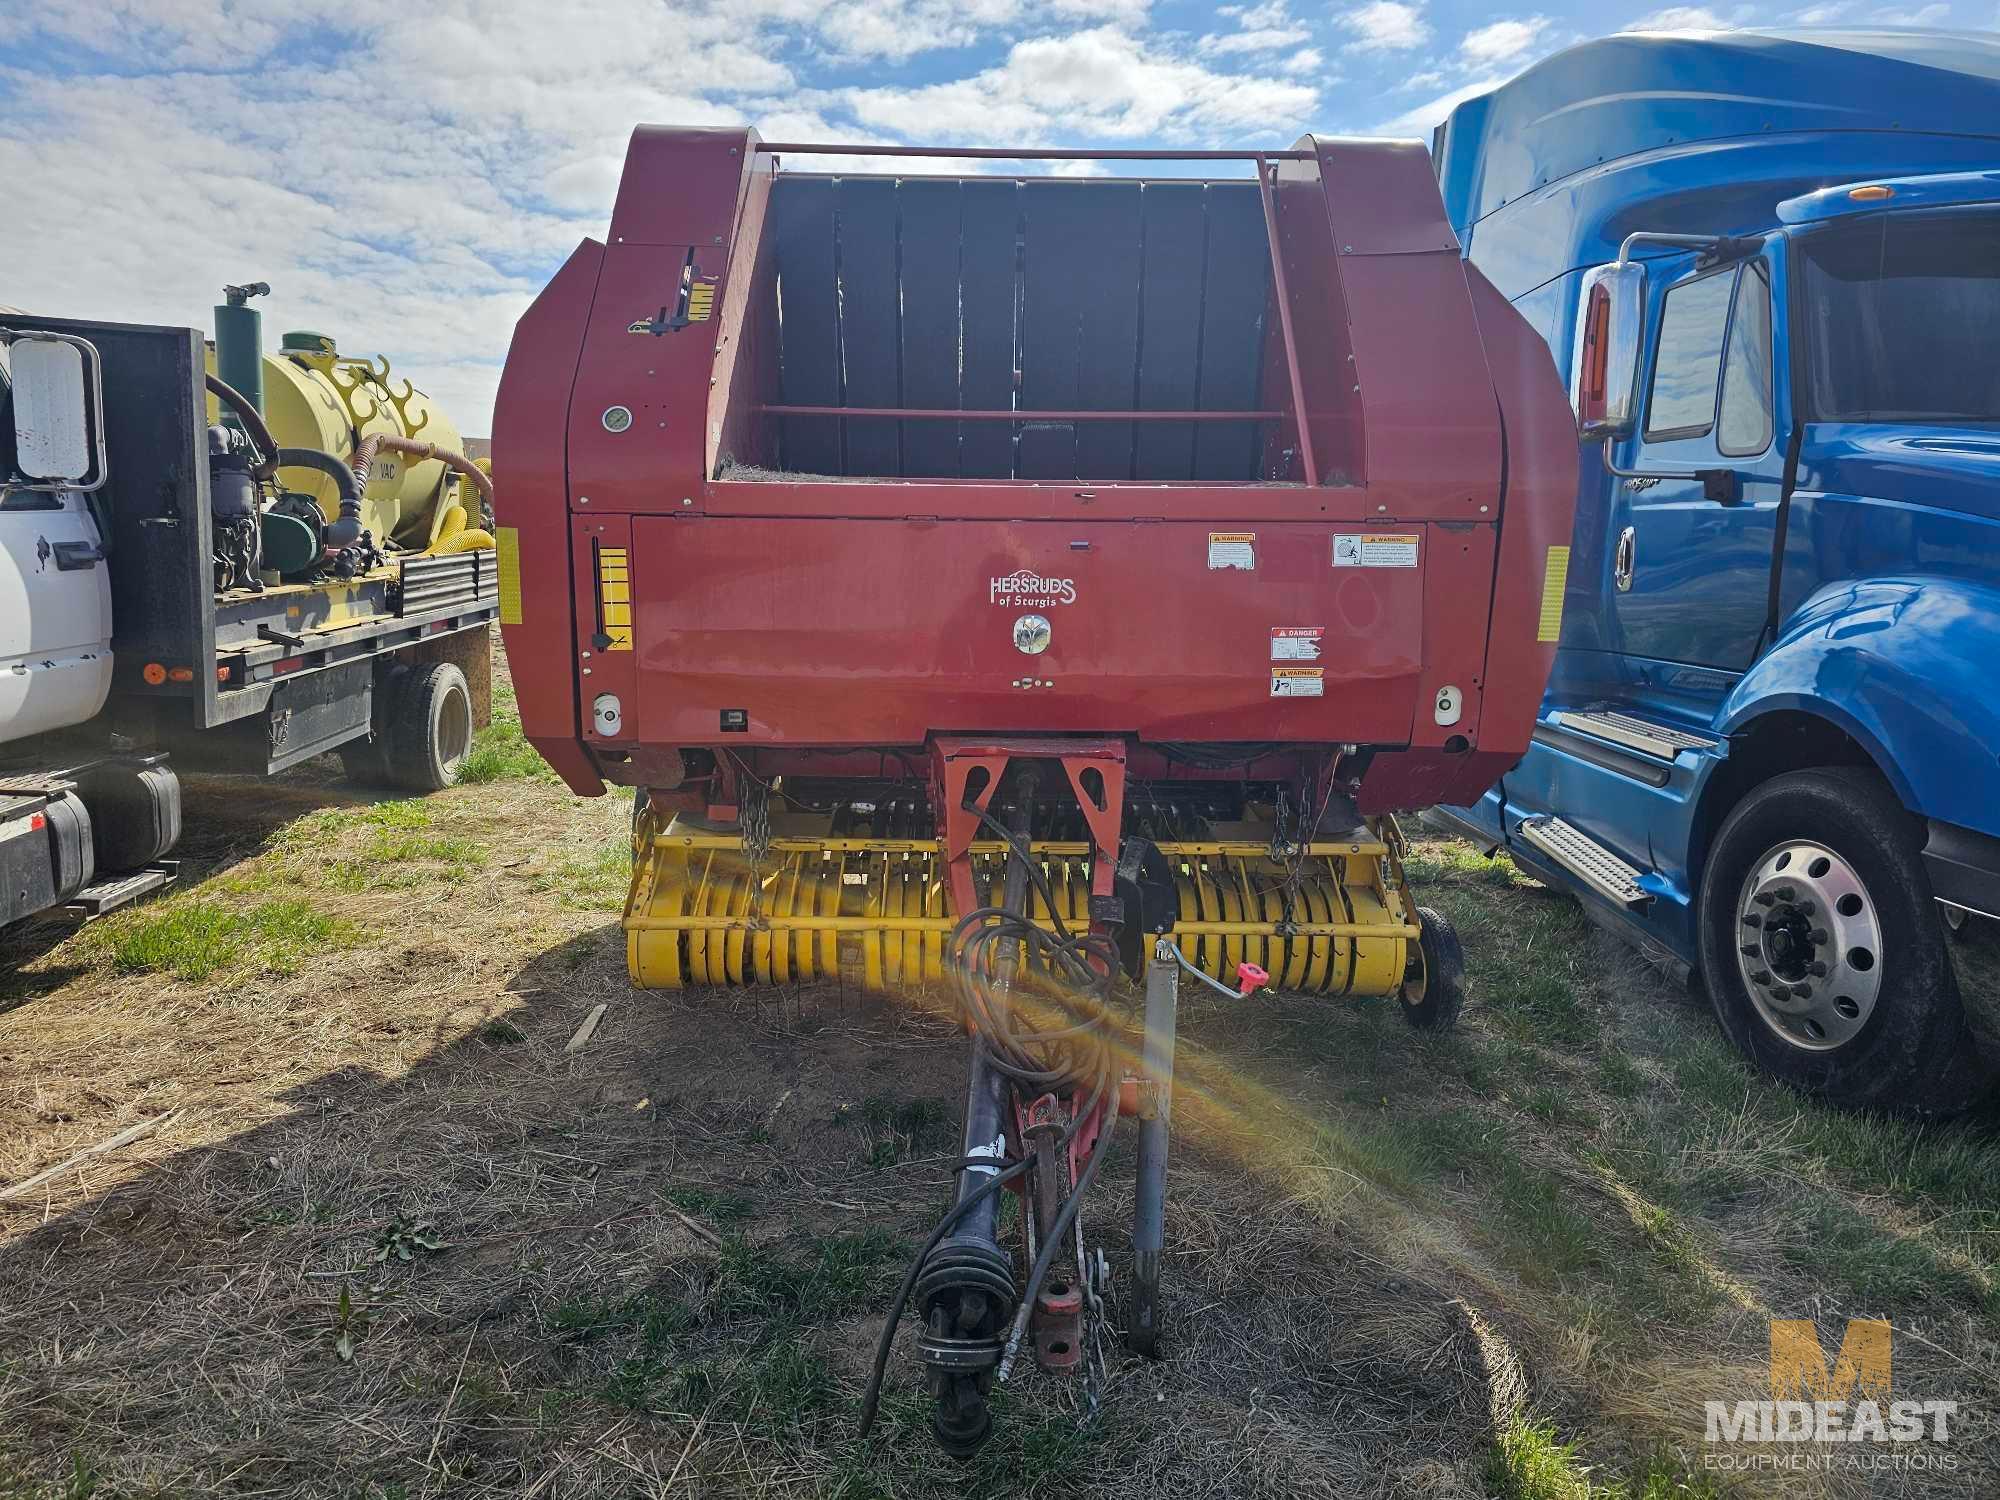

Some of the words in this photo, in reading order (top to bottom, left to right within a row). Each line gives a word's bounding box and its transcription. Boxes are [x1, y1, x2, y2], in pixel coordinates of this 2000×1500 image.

[380, 463, 395, 480] VAC
[990, 577, 1077, 604] HERSRUDS
[999, 595, 1012, 608] of
[1014, 595, 1058, 608] Sturgis
